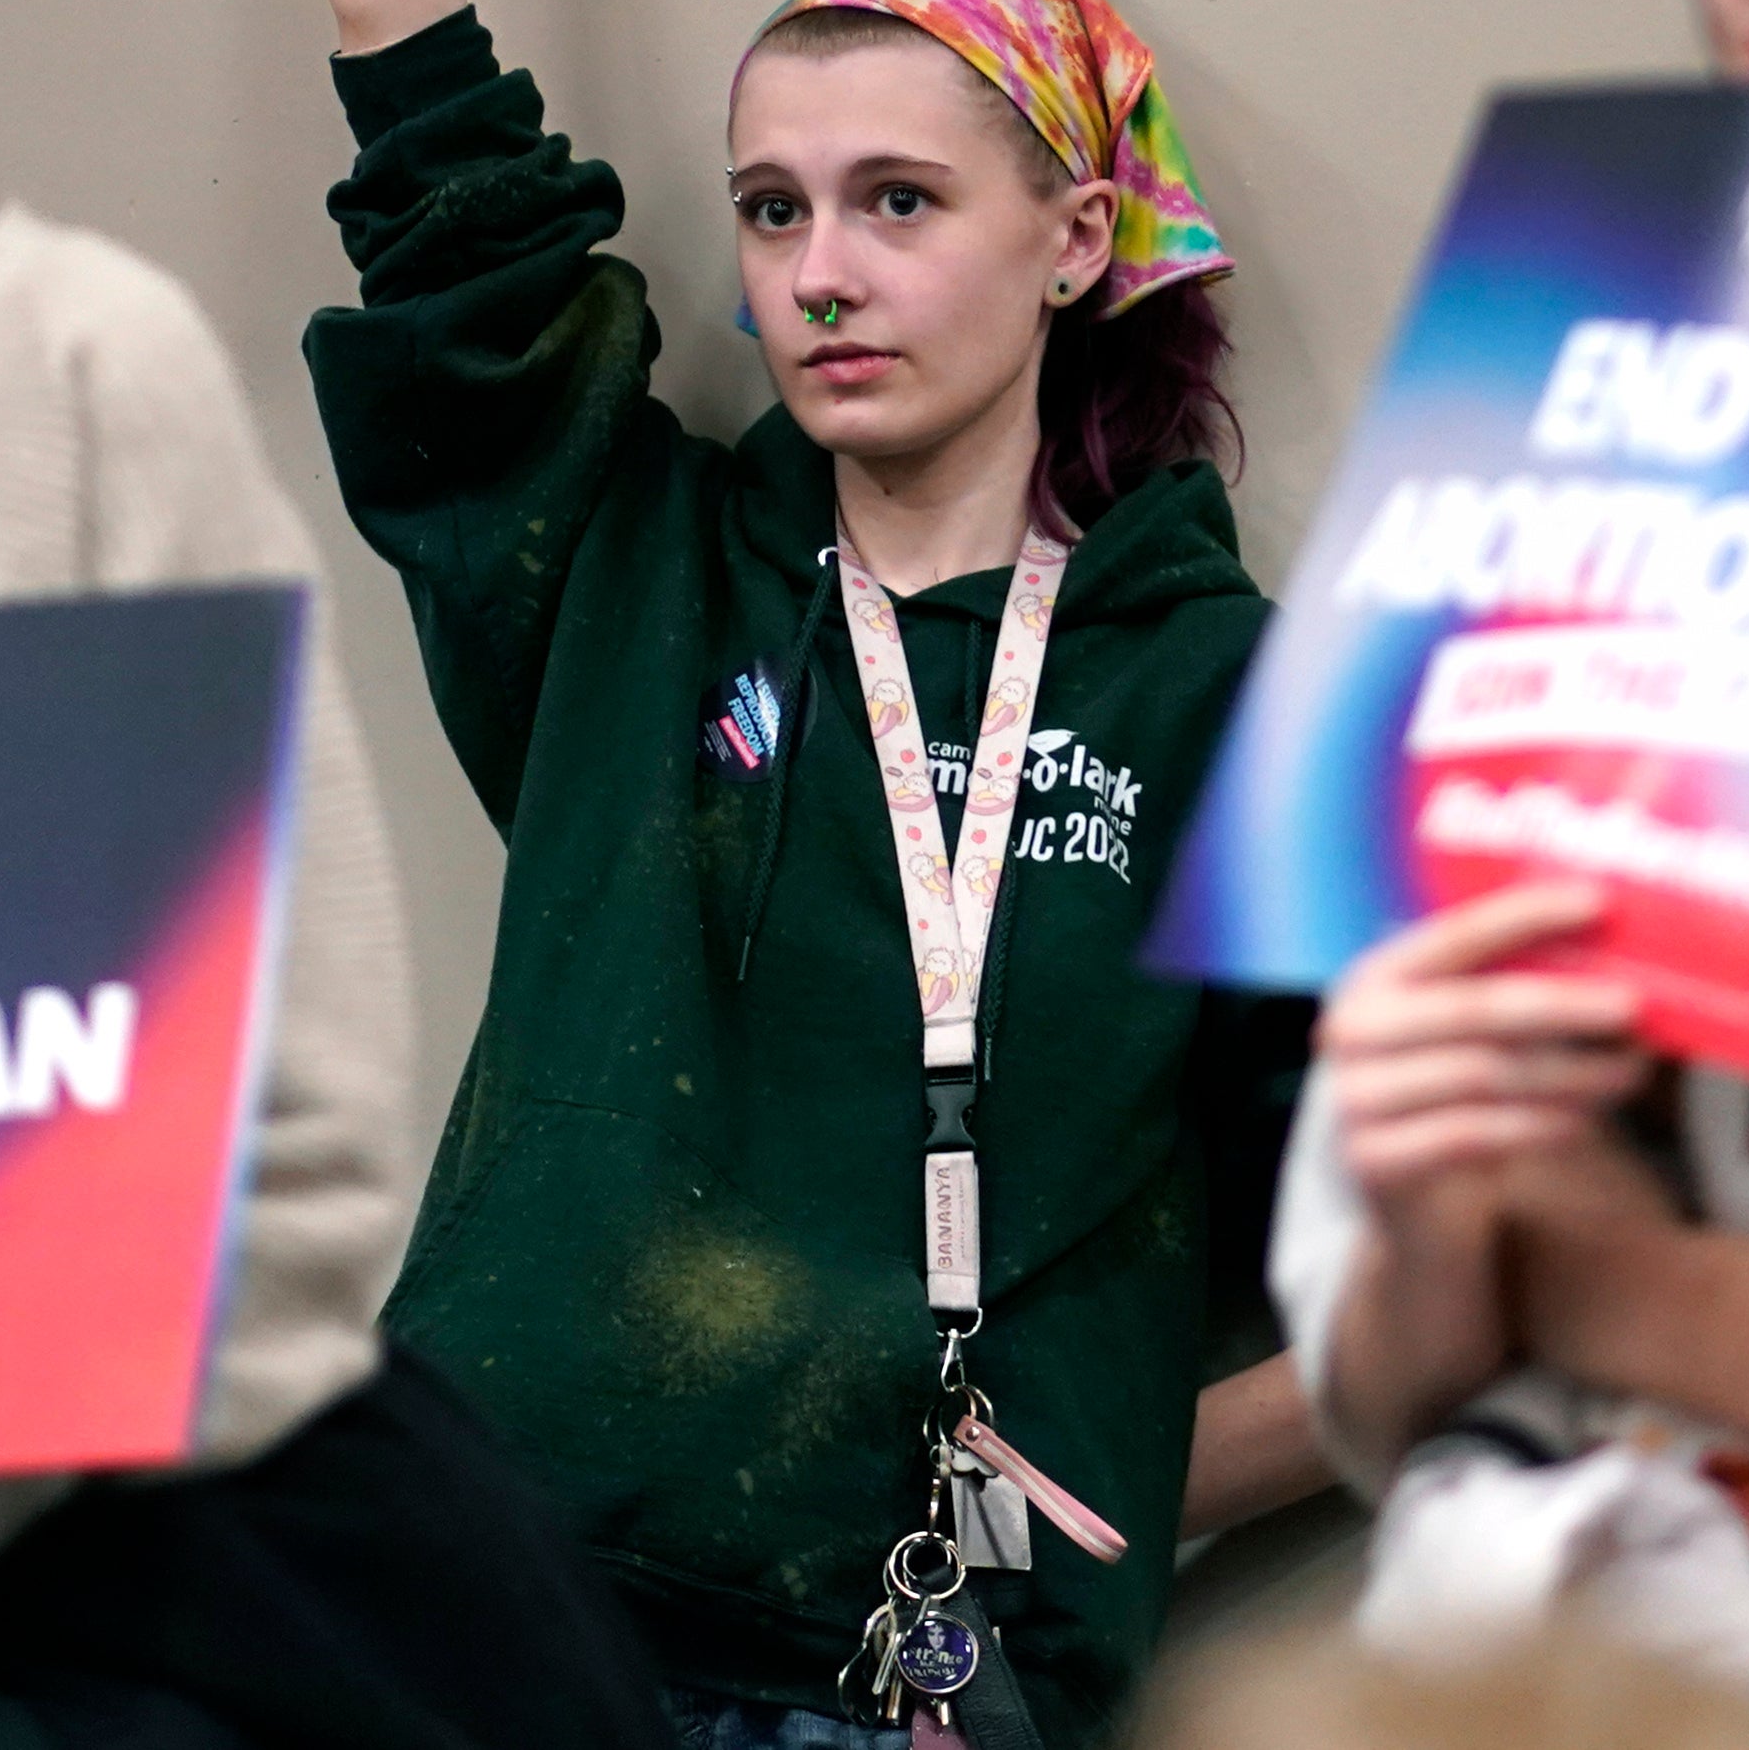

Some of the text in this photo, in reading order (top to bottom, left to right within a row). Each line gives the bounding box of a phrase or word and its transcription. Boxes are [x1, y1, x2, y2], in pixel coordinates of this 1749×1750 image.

[728, 697, 764, 756] FREEDOM
[735, 673, 775, 757] REPRODUCTI
[928, 741, 971, 760] cam
[936, 1167, 953, 1269] BANANYA
